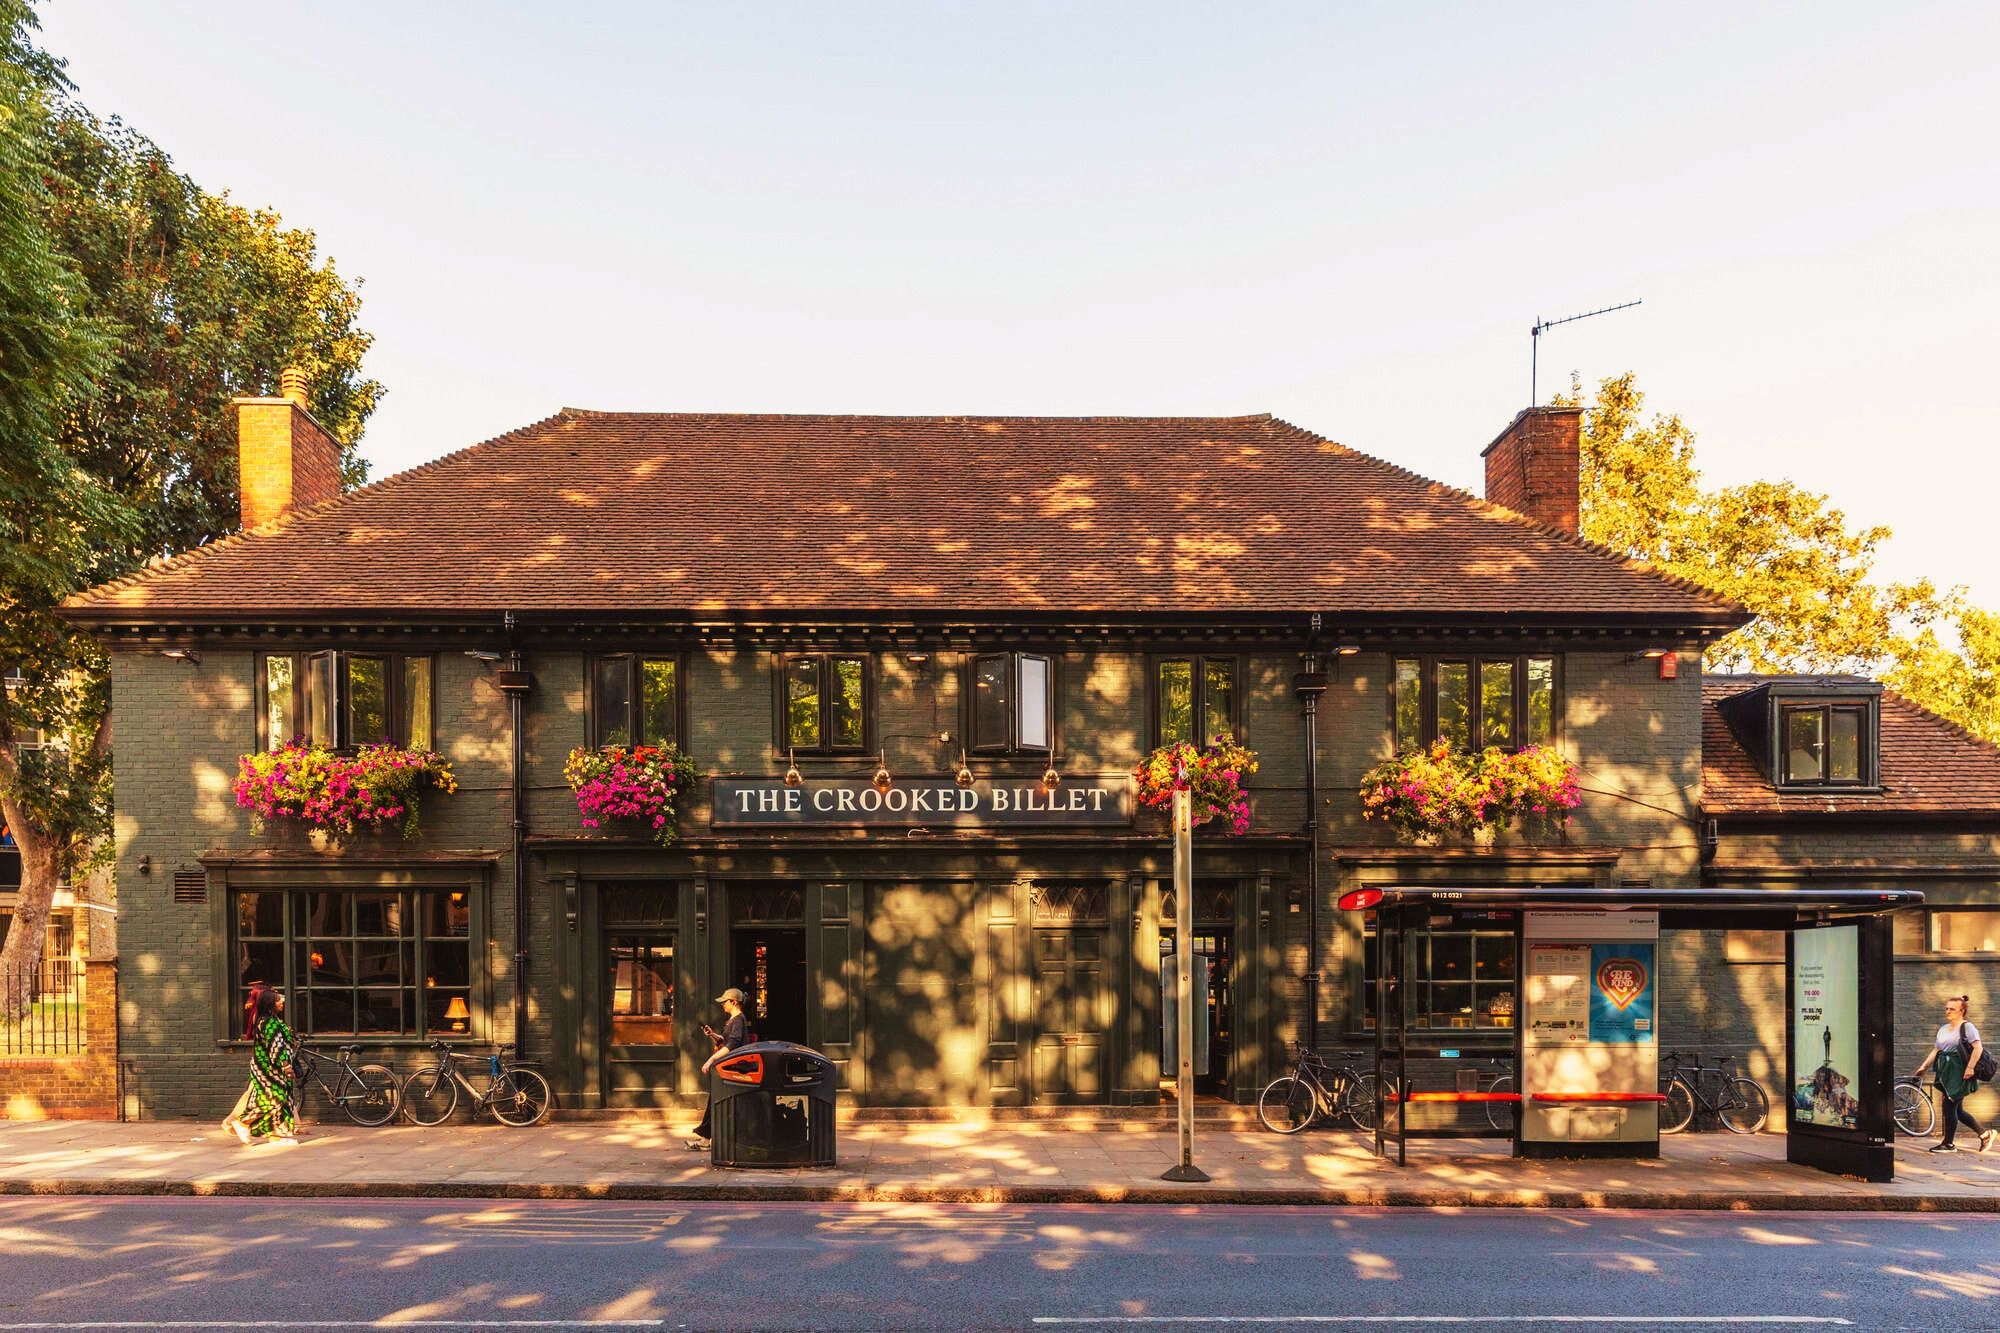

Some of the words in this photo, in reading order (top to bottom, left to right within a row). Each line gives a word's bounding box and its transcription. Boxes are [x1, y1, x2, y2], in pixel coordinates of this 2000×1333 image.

[735, 789, 802, 812] THE
[813, 788, 980, 812] CROOKED
[991, 788, 1109, 812] BILLET
[1610, 970, 1633, 980] BE
[1611, 979, 1634, 988] KIND
